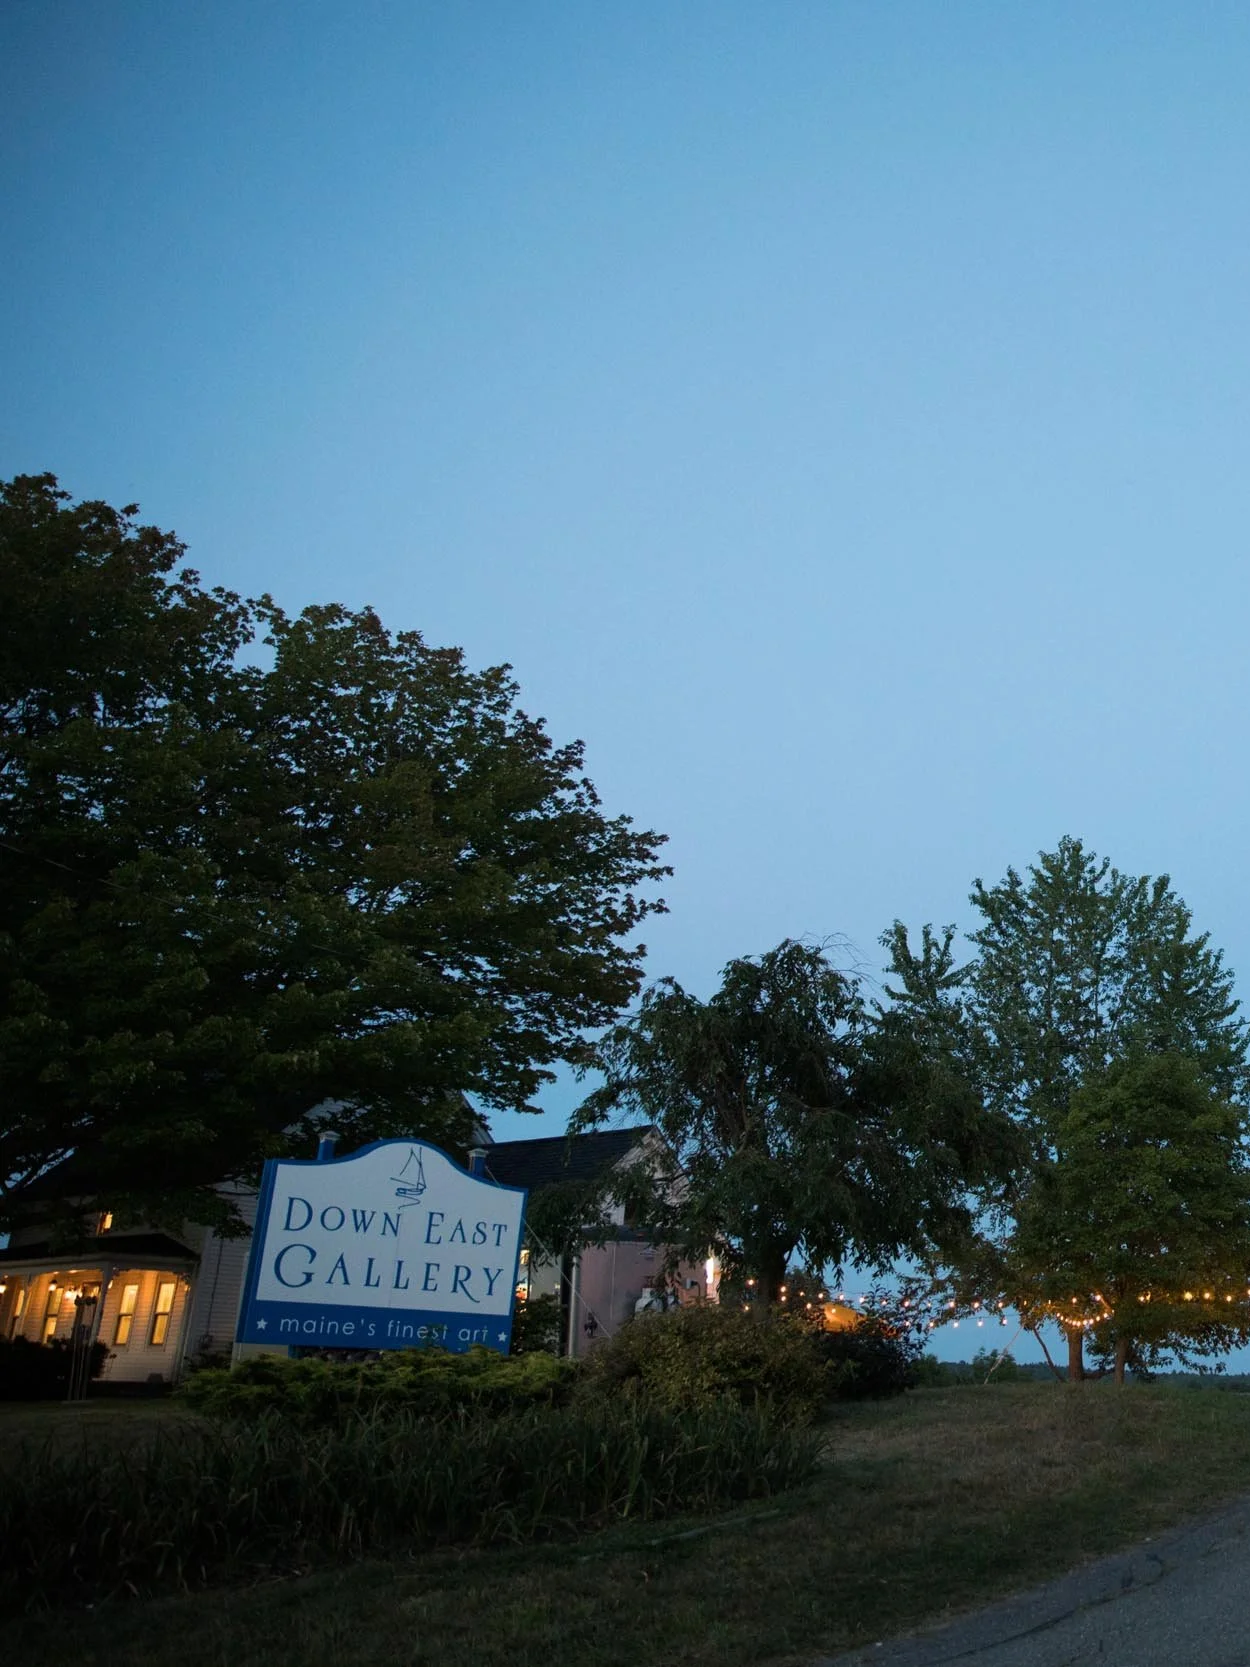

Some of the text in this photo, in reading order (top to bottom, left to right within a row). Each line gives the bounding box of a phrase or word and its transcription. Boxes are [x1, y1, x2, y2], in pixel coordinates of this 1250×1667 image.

[284, 1197, 507, 1246] DOWN EAST
[274, 1243, 504, 1303] GALLERY
[280, 1316, 488, 1342] maine's finest art
